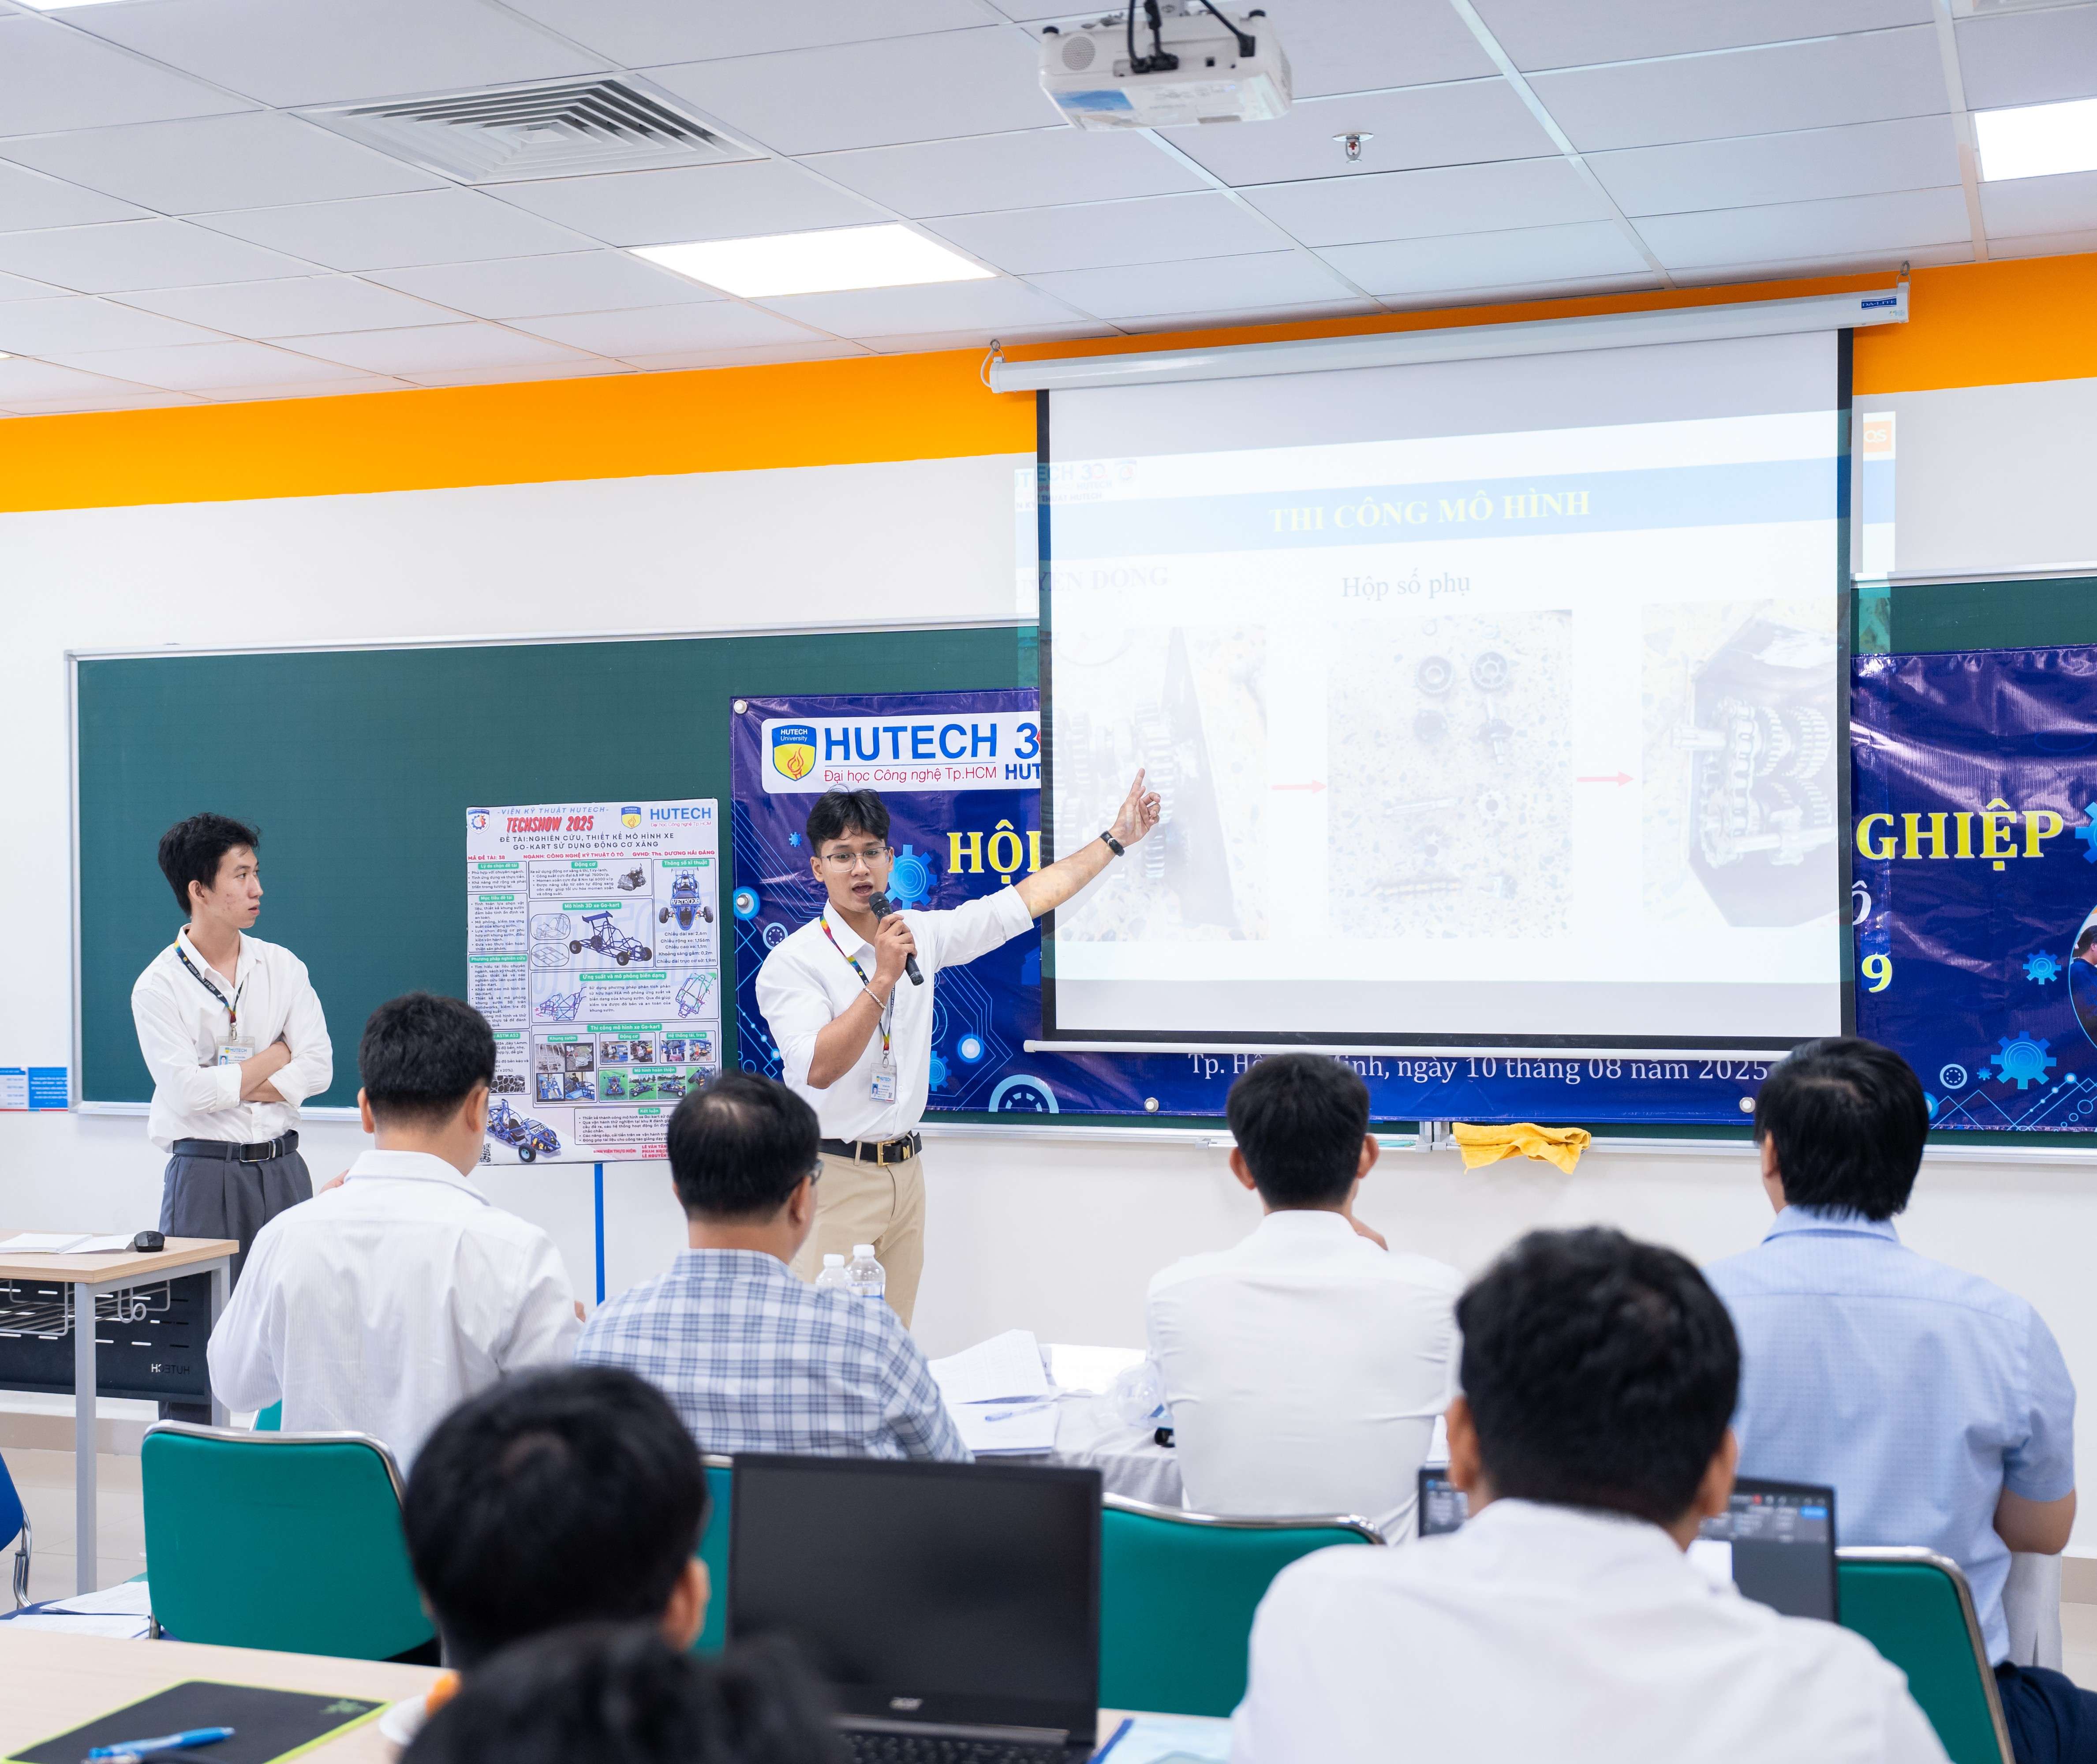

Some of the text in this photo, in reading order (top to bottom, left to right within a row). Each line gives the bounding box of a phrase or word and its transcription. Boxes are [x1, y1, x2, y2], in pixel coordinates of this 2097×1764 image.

[1268, 487, 1590, 532] THI CÔNG MÔ HÌNH
[1342, 567, 1470, 601] Hộp số phụ
[825, 723, 997, 761] HUTECH
[824, 766, 996, 783] Đại học Công nghệ Tp.HCM
[507, 815, 594, 833] TECHSHOW 2025
[650, 807, 711, 820] HUTECH
[500, 834, 510, 842] ĐỀ
[587, 831, 609, 840] THIẾT
[613, 831, 622, 840] KẾ
[594, 841, 618, 849] ĐỘNG
[1856, 797, 2063, 871] GHIỆP
[947, 819, 1041, 884] HỘI
[1862, 953, 1892, 993] 9
[1188, 1053, 1225, 1079] Tp.
[1398, 1056, 1458, 1083] ngày
[1466, 1057, 1496, 1077] 10
[1505, 1058, 1581, 1085] tháng
[1589, 1059, 1622, 1079] 08
[1631, 1058, 1690, 1080] năm
[1699, 1059, 1768, 1080] 2025
